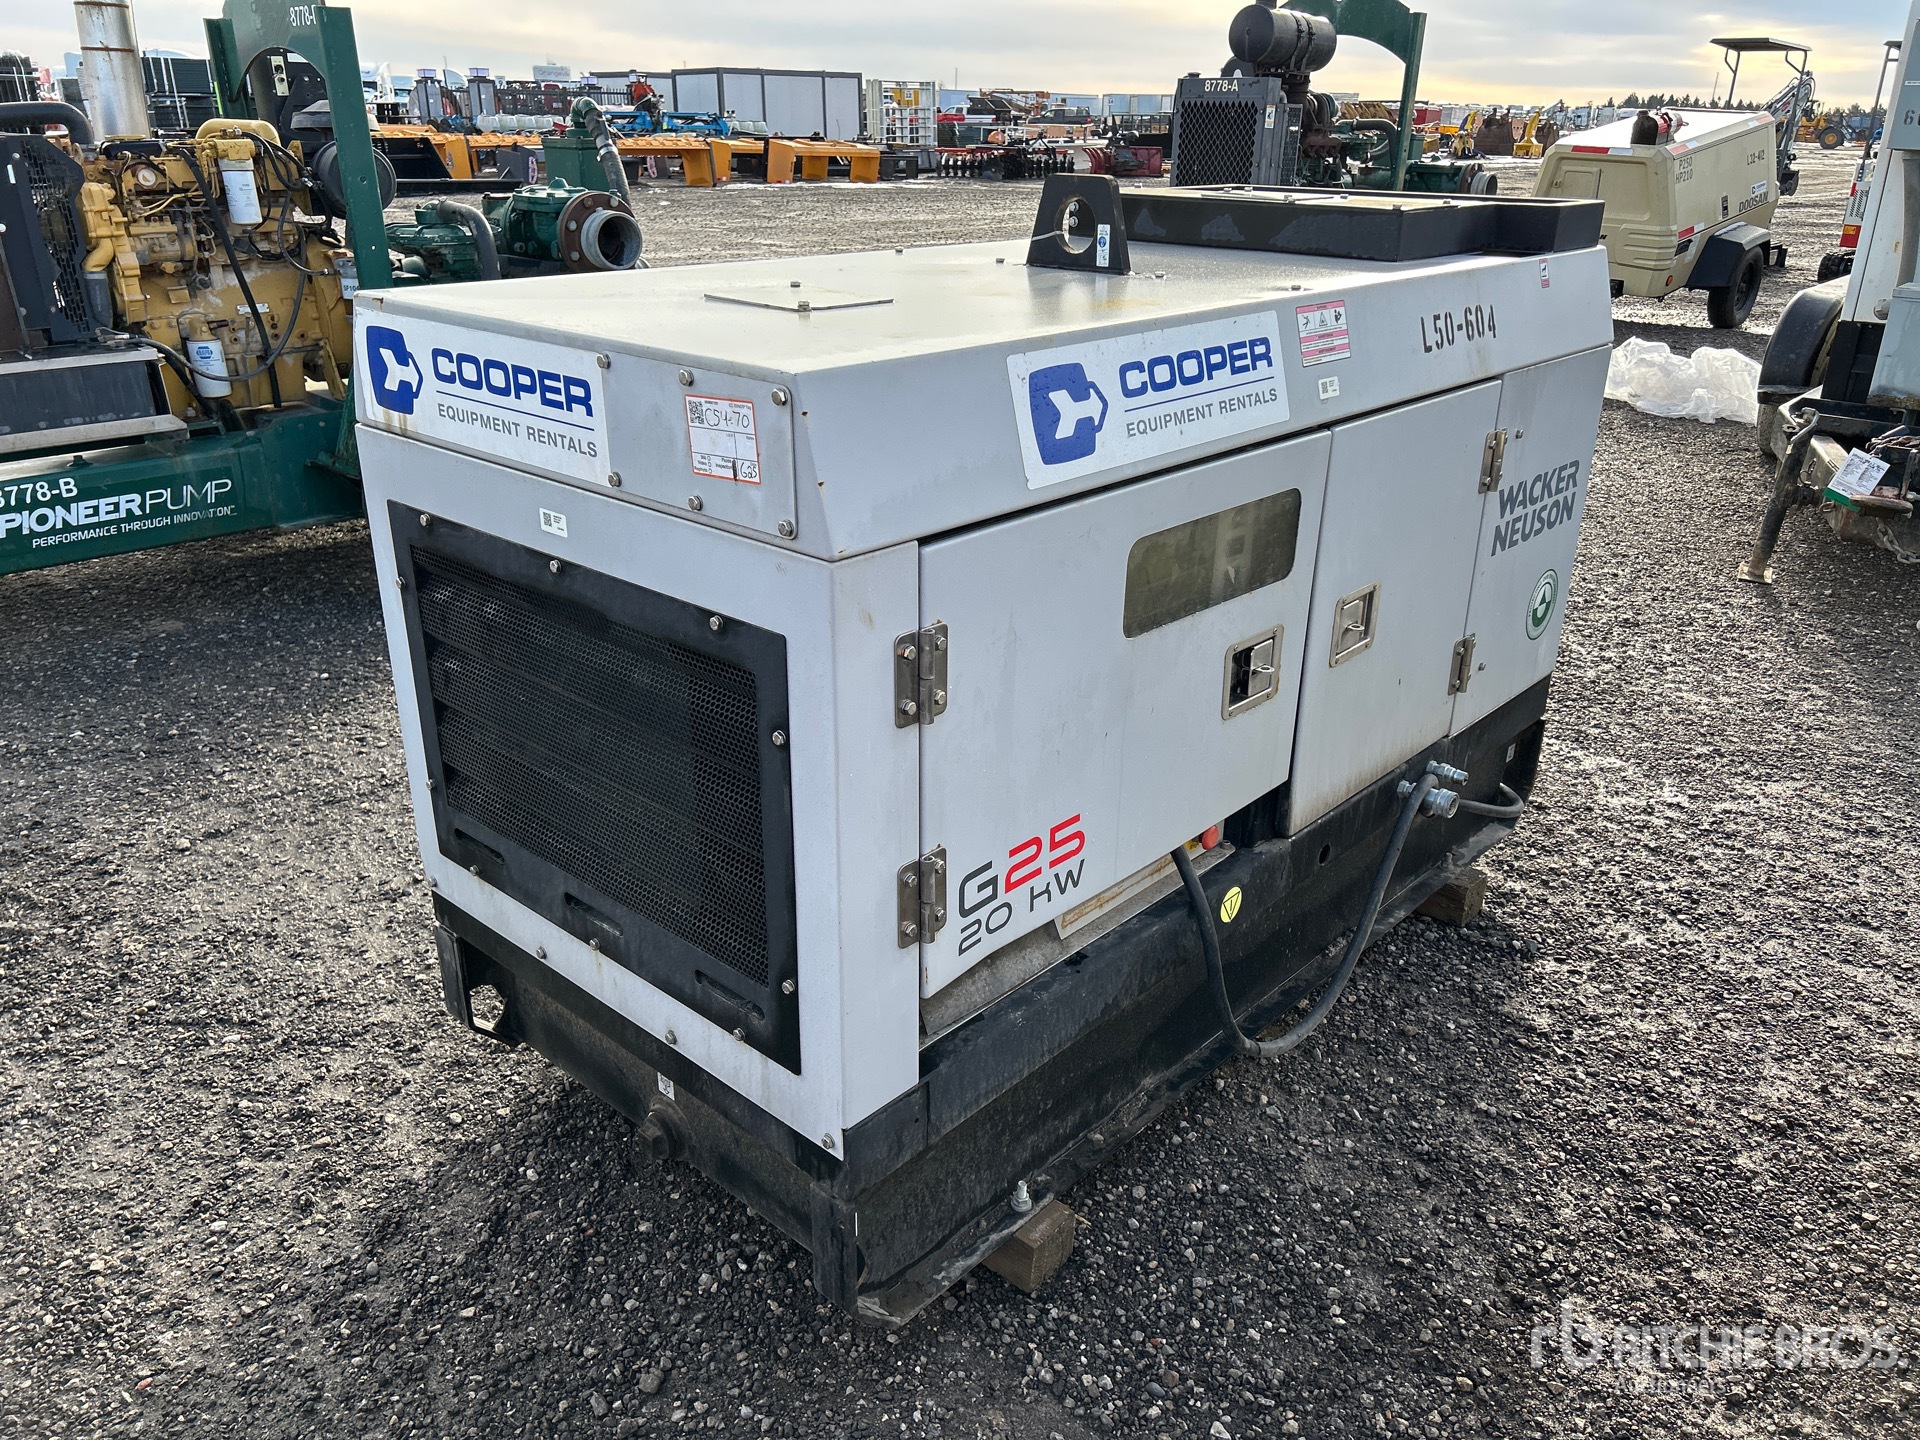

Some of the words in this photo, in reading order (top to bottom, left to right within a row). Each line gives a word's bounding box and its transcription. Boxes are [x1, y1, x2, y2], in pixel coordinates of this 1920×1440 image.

[1204, 79, 1239, 92] 8778-A
[1738, 191, 1769, 213] DOOSAN
[1420, 304, 1497, 353] L50-604
[431, 347, 594, 418] COOPER
[1118, 336, 1273, 398] COOPER
[437, 403, 520, 438] EQUIPMENT
[526, 425, 598, 458] RENTALS
[1126, 403, 1213, 438] EQUIPMENT
[1219, 388, 1278, 415] RENTALS
[1498, 460, 1580, 519] WACKER
[32, 525, 118, 549] PERFORMANCE
[120, 515, 171, 532] THROUGH
[1490, 491, 1577, 557] NEUSON
[958, 813, 1086, 918] G25
[958, 902, 1013, 957] 20
